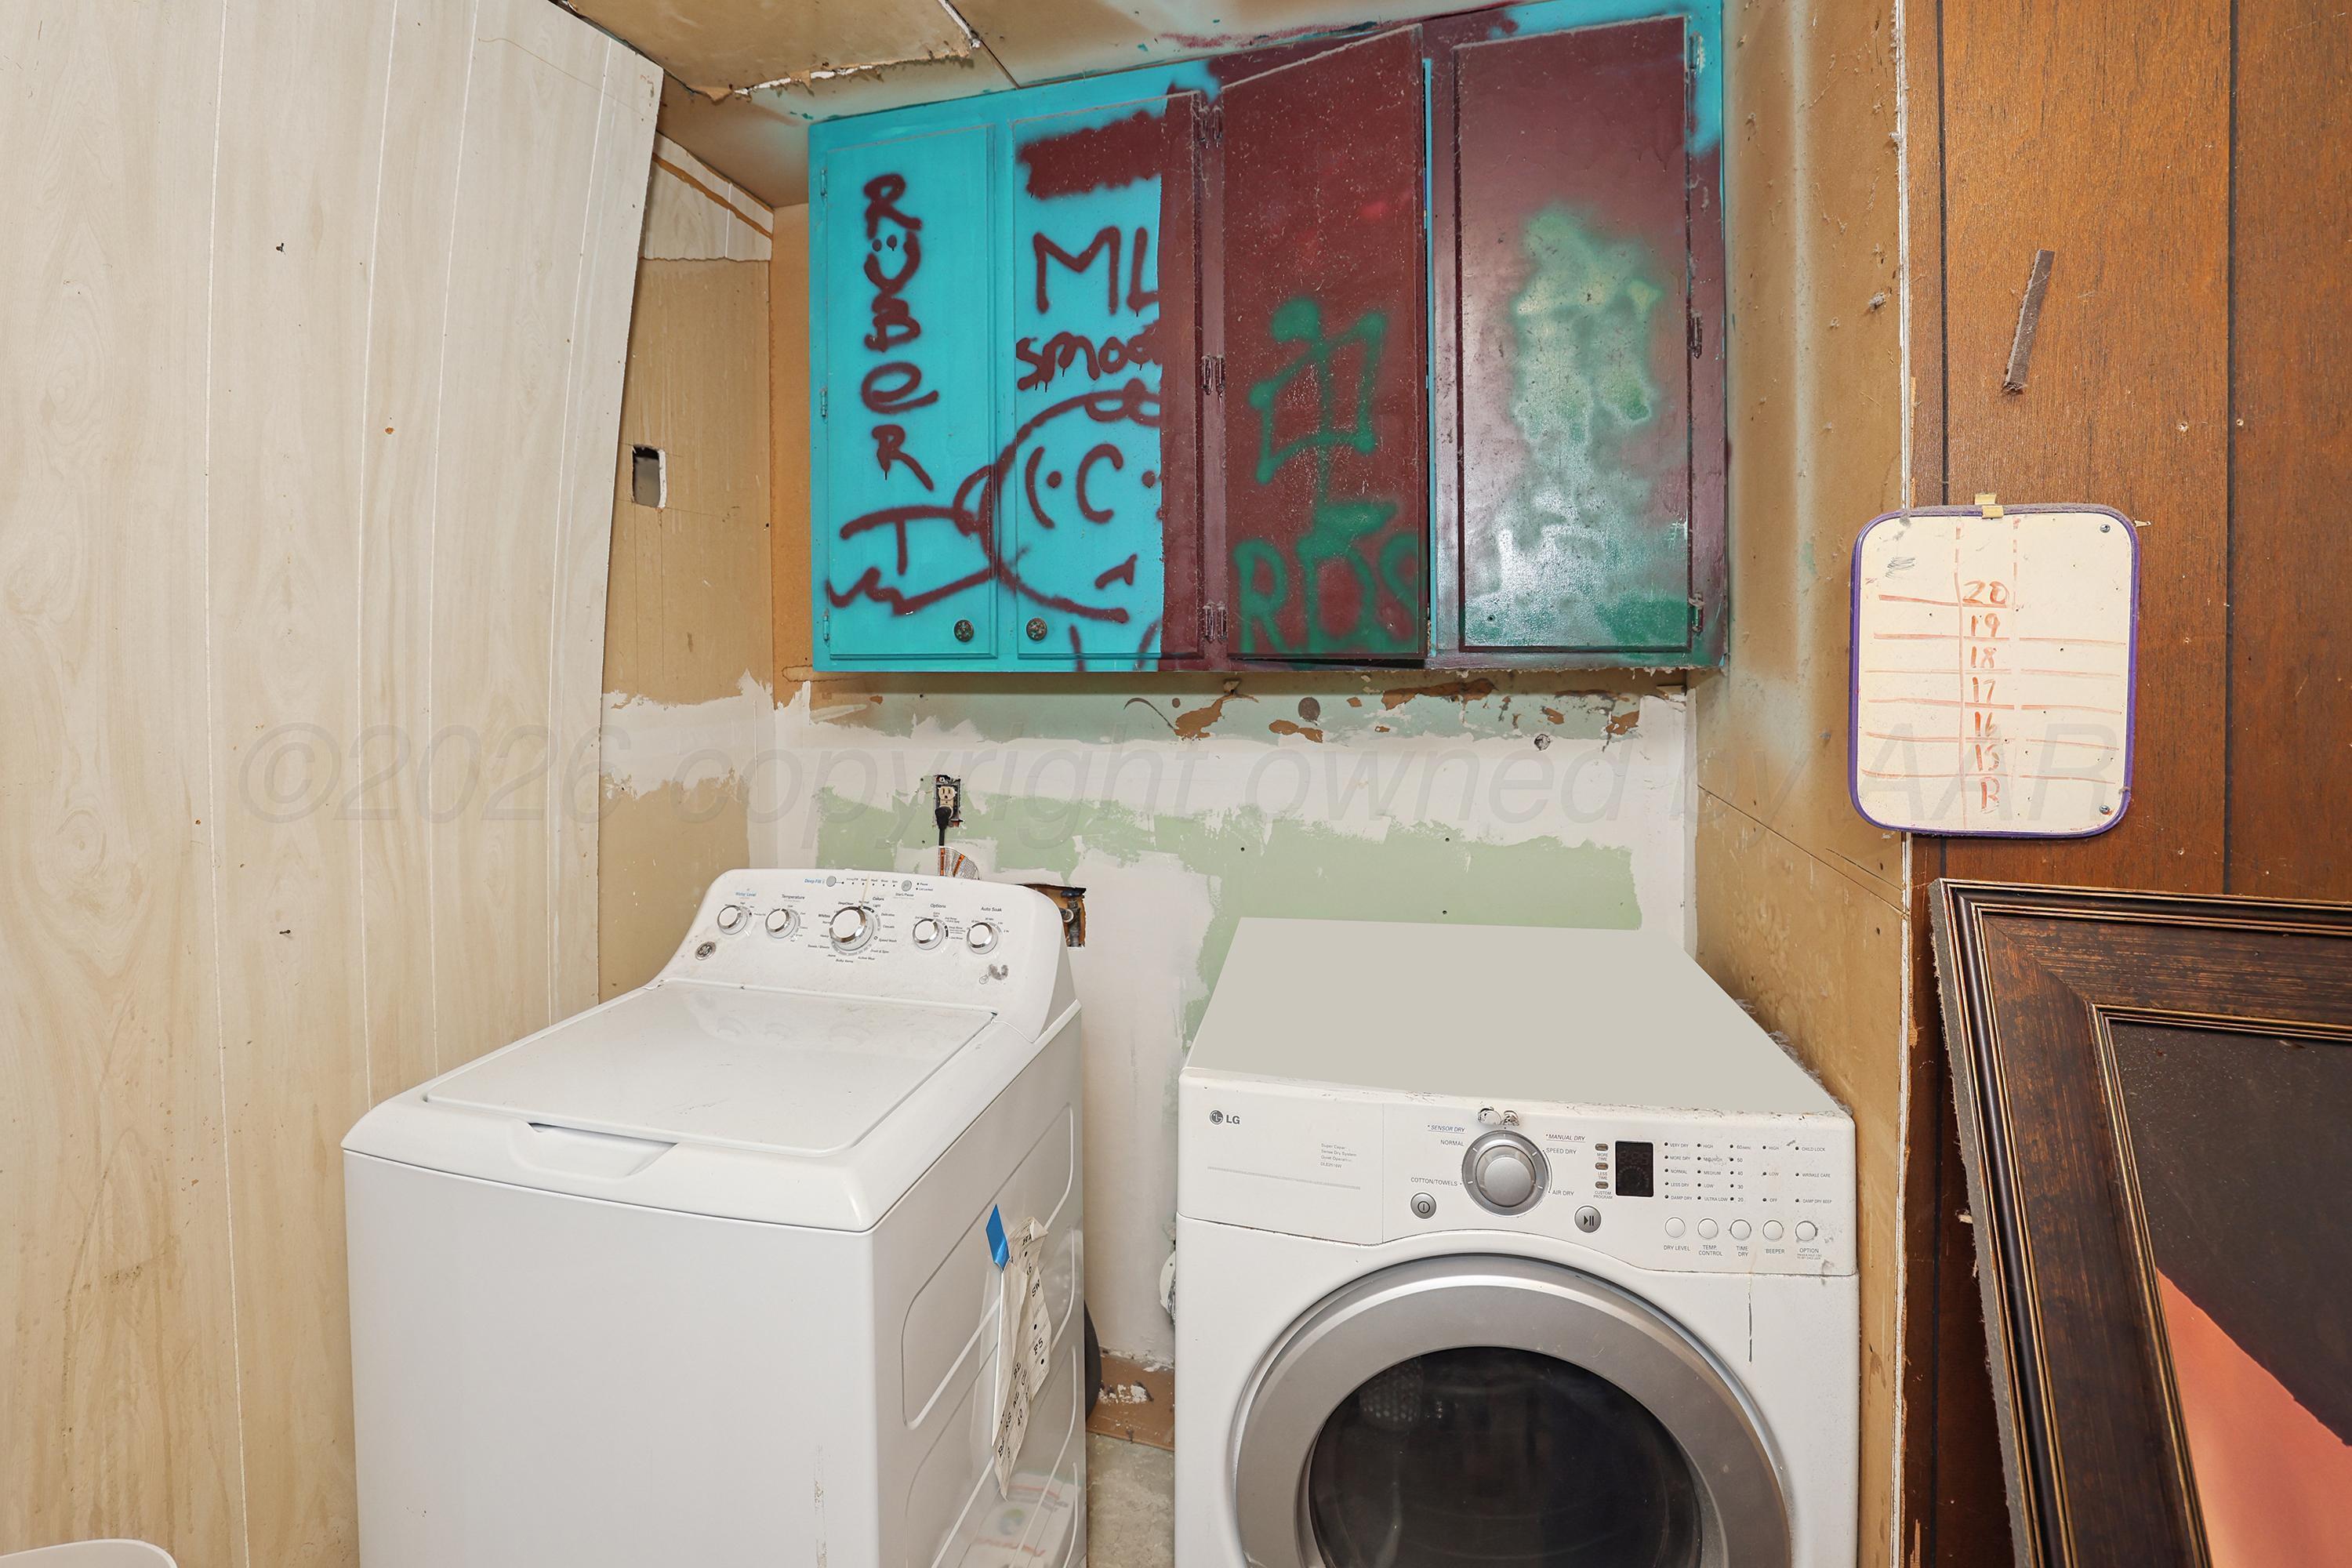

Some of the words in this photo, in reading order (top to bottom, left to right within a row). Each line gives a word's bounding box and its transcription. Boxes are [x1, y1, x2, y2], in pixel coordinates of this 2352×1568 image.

[1962, 580, 2009, 604] 20
[1971, 613, 2001, 638] 19
[1970, 645, 1997, 669] 18
[1972, 677, 1996, 703] 17
[1974, 711, 1998, 737] 16
[1975, 744, 2000, 771] 15
[1226, 1115, 1240, 1124] LG
[1410, 1177, 1458, 1186] COTTON/TOWELS
